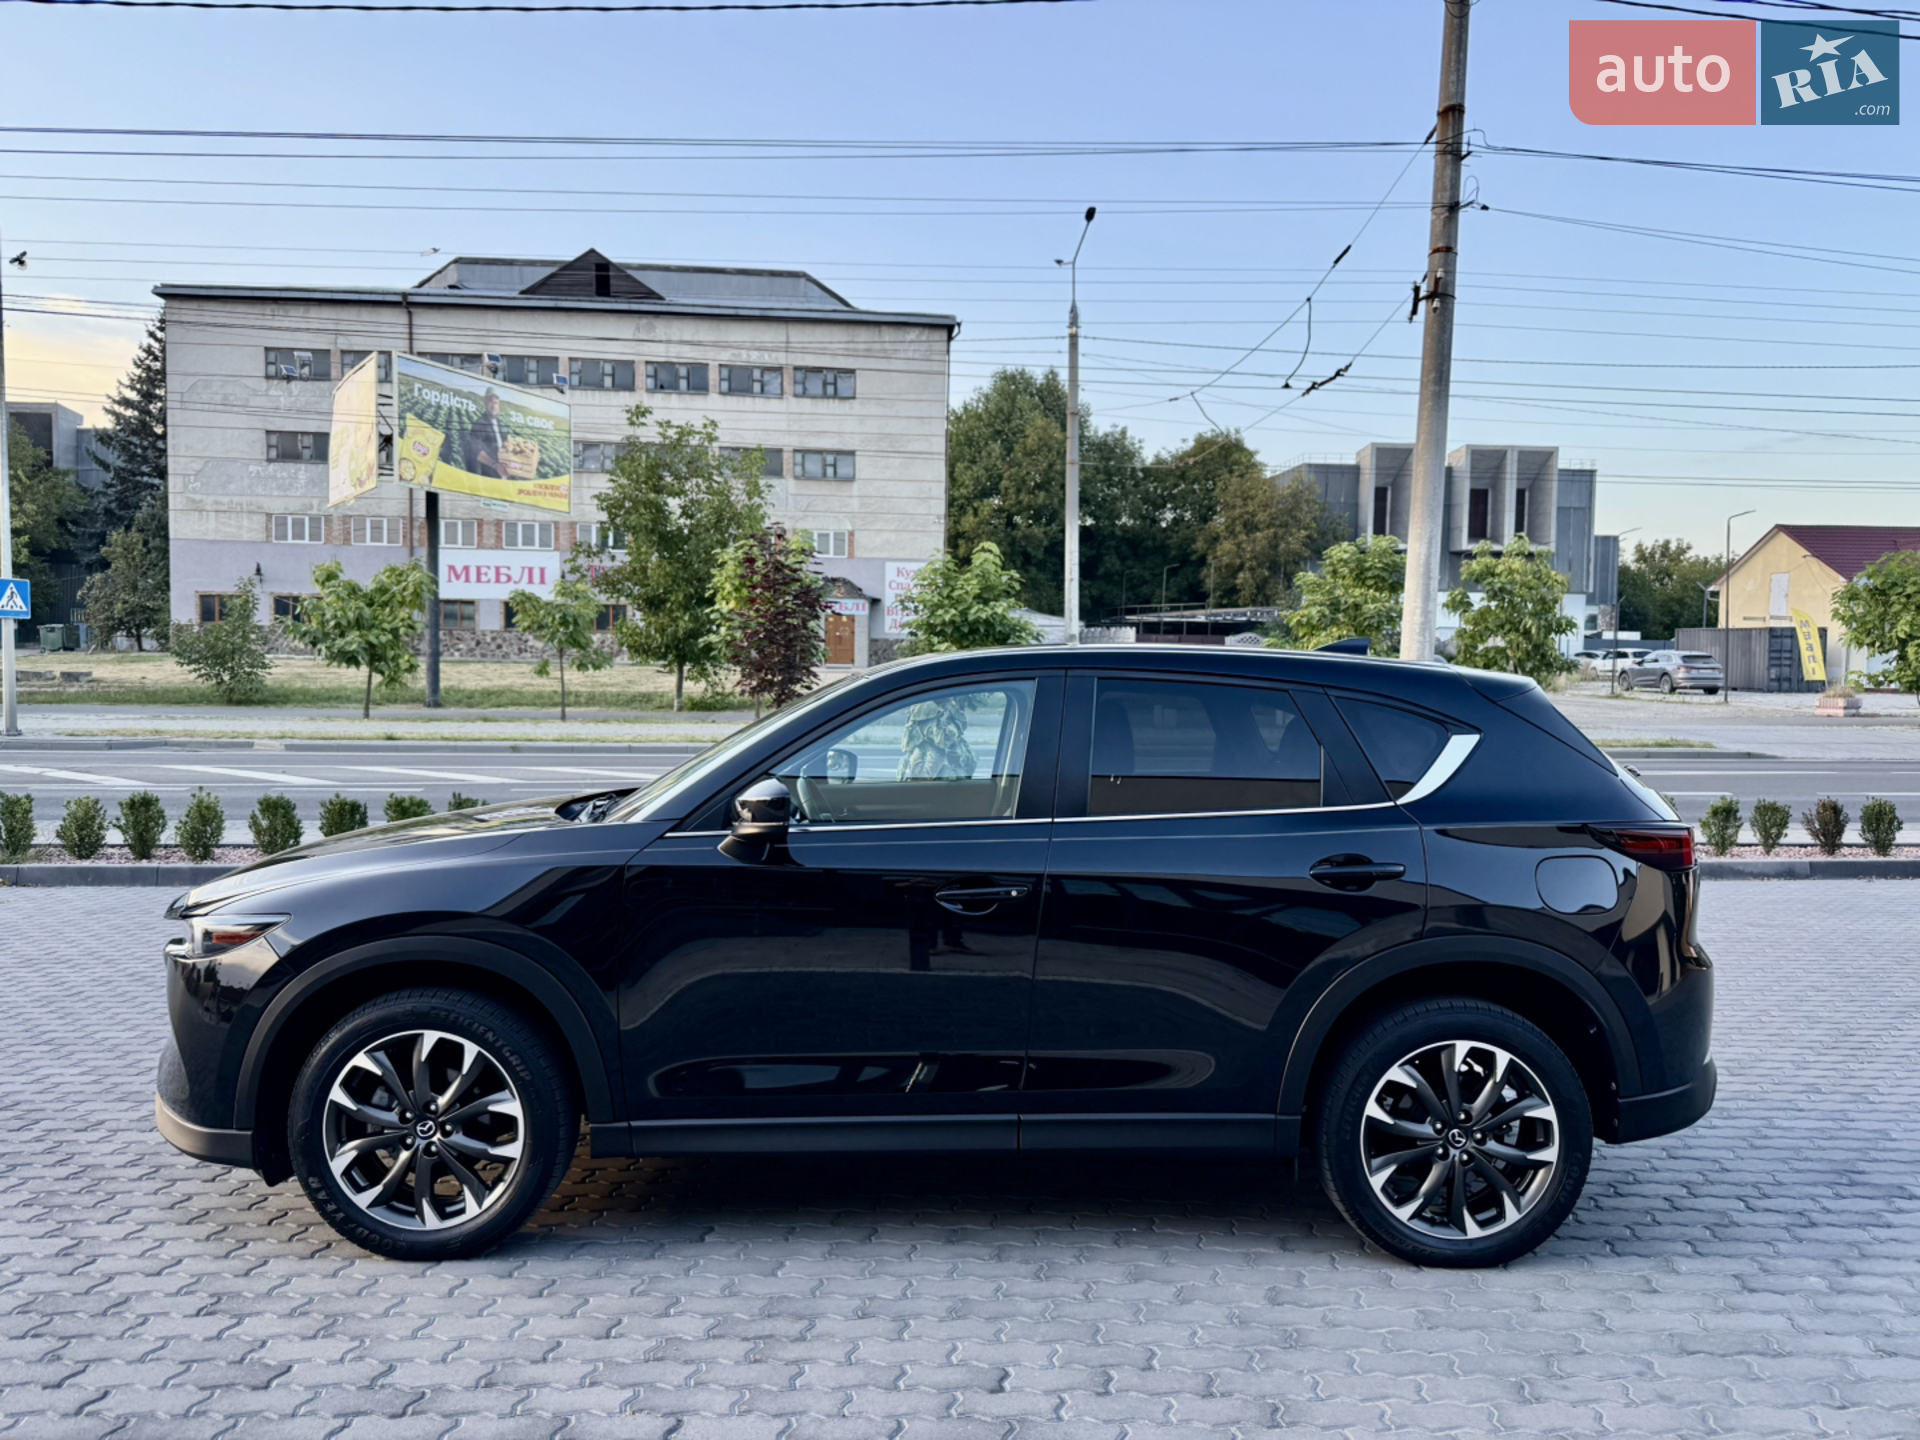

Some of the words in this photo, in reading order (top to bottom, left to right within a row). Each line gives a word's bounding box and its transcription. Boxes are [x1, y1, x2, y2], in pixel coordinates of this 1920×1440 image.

[413, 383, 477, 412] Гордість
[509, 411, 524, 424] за
[526, 415, 555, 430] своє
[446, 564, 548, 585] МЕБЛІ
[430, 1010, 533, 1081] EFFICIENTGRIP
[307, 1176, 408, 1253] GOODYEAR
